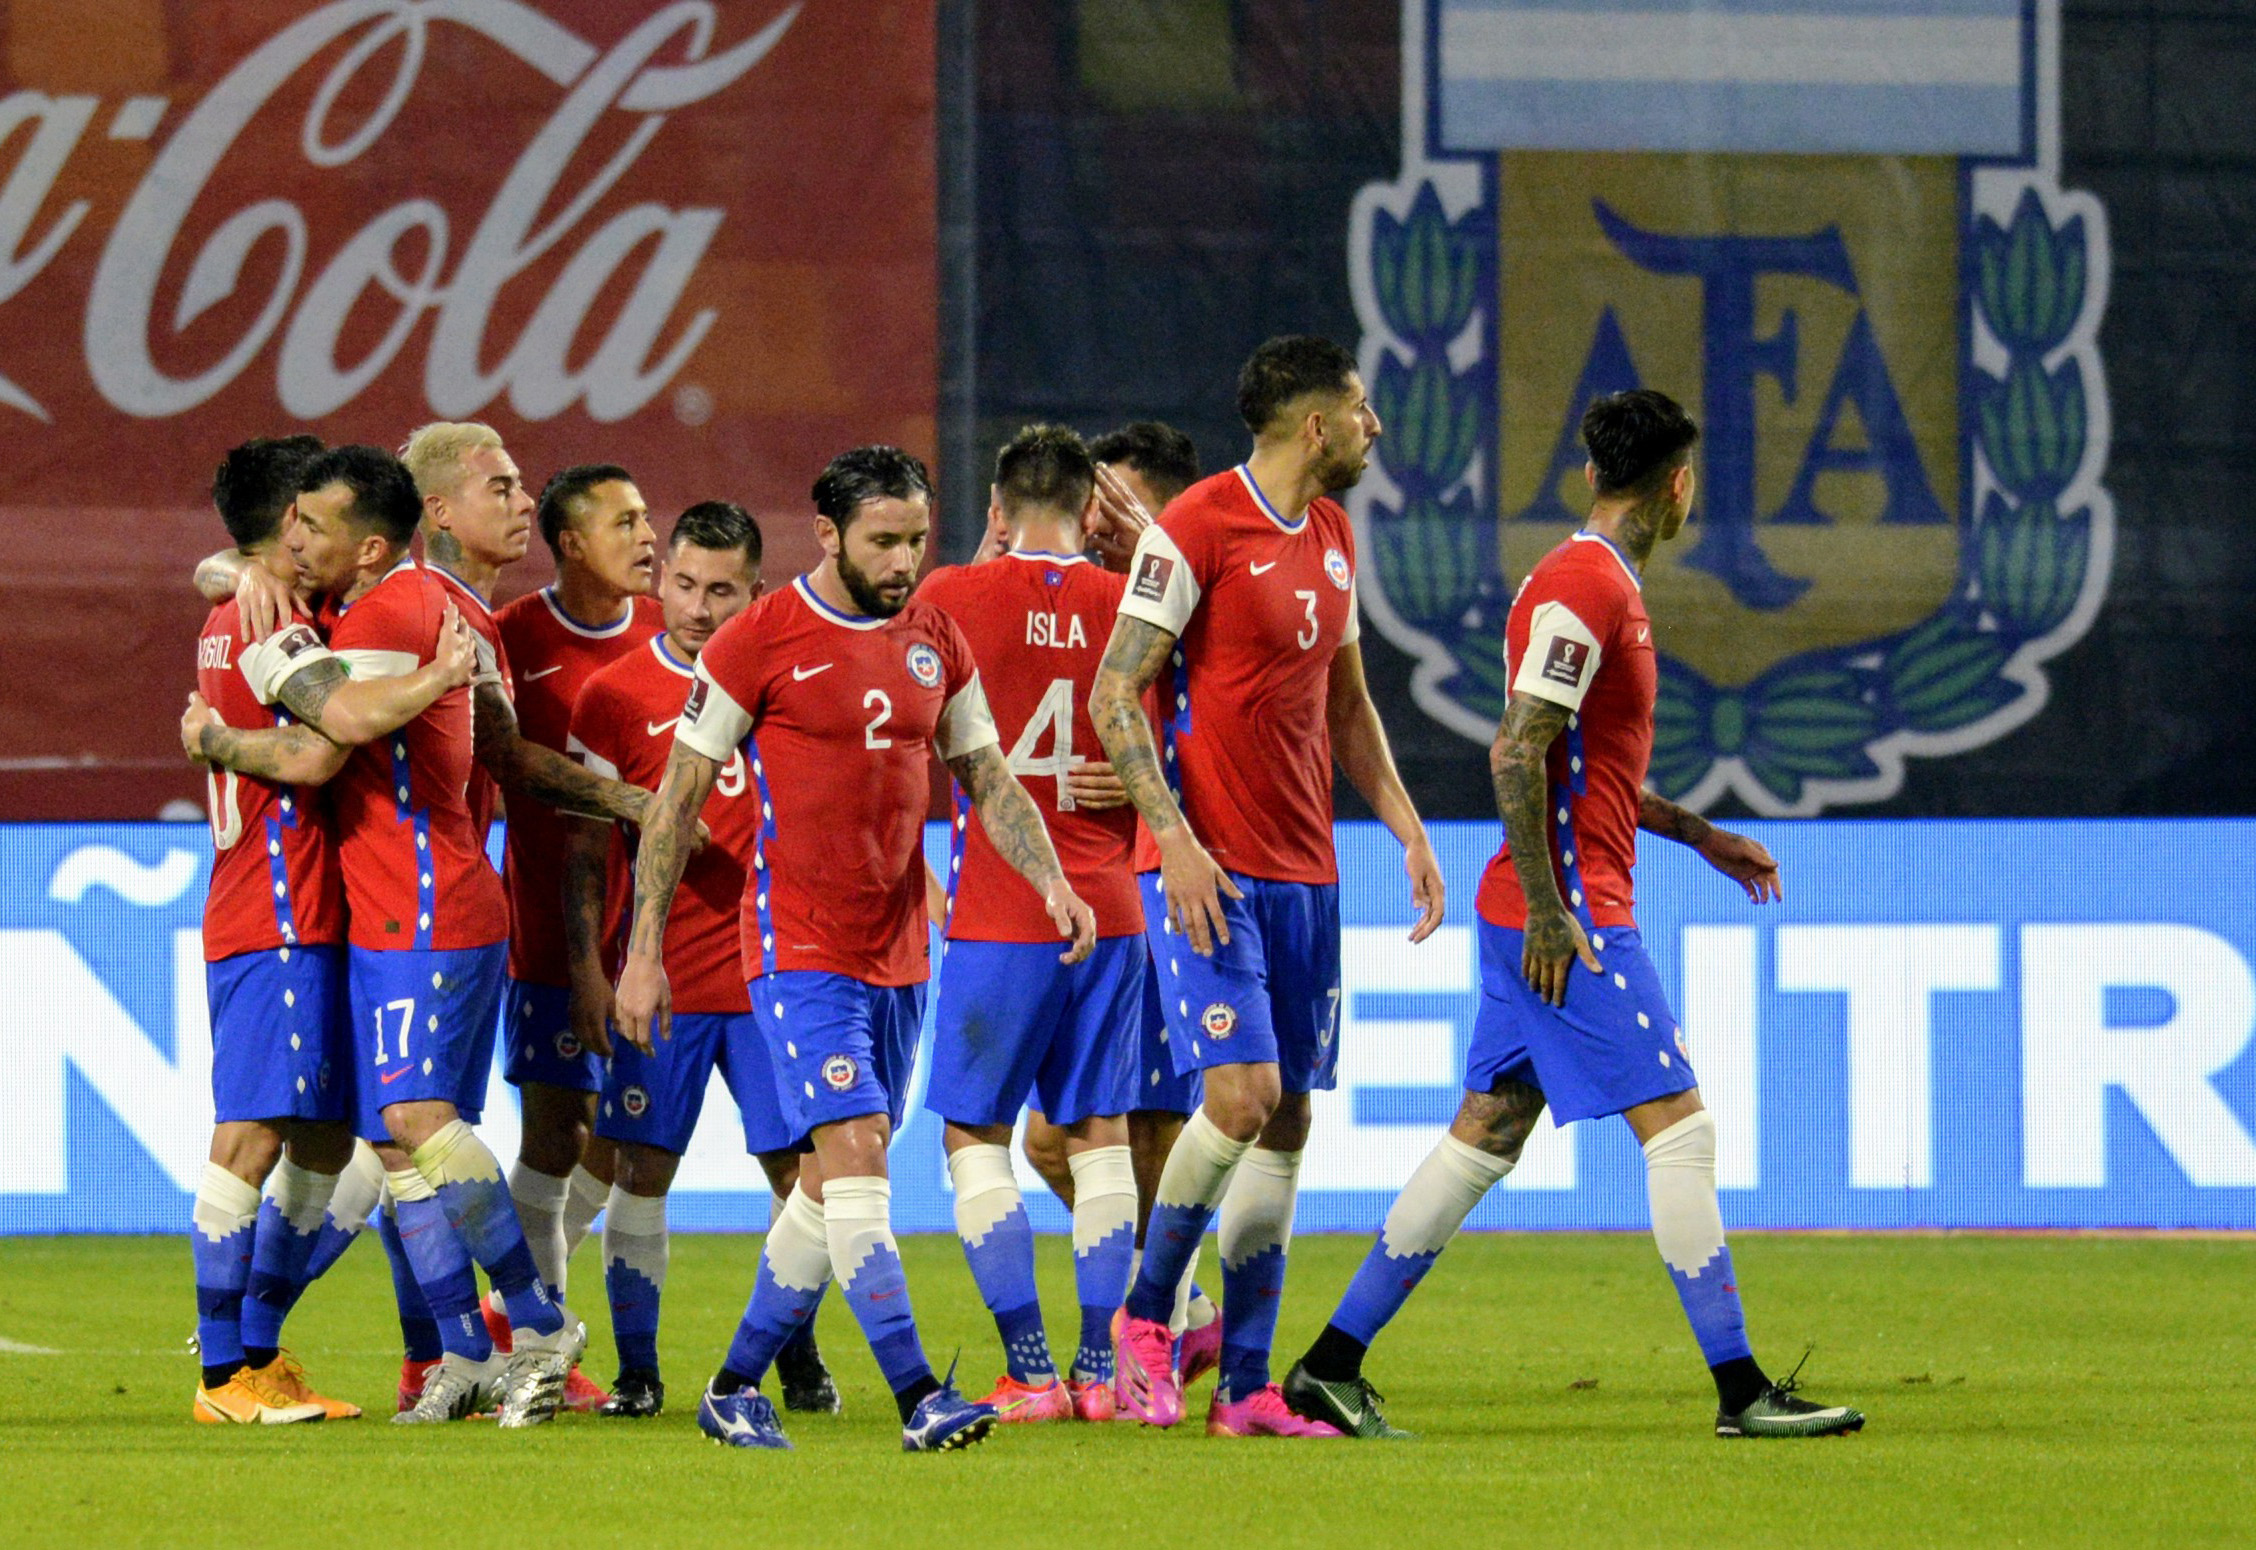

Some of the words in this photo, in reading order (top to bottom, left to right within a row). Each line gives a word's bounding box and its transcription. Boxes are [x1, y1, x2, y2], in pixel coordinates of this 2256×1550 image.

[1505, 197, 1953, 612] AFA
[1026, 610, 1088, 649] ISLA
[1294, 589, 1318, 650] 3
[863, 688, 892, 750] 2
[1006, 678, 1086, 812] 4
[374, 997, 415, 1066] 17
[1319, 987, 1340, 1048] 3
